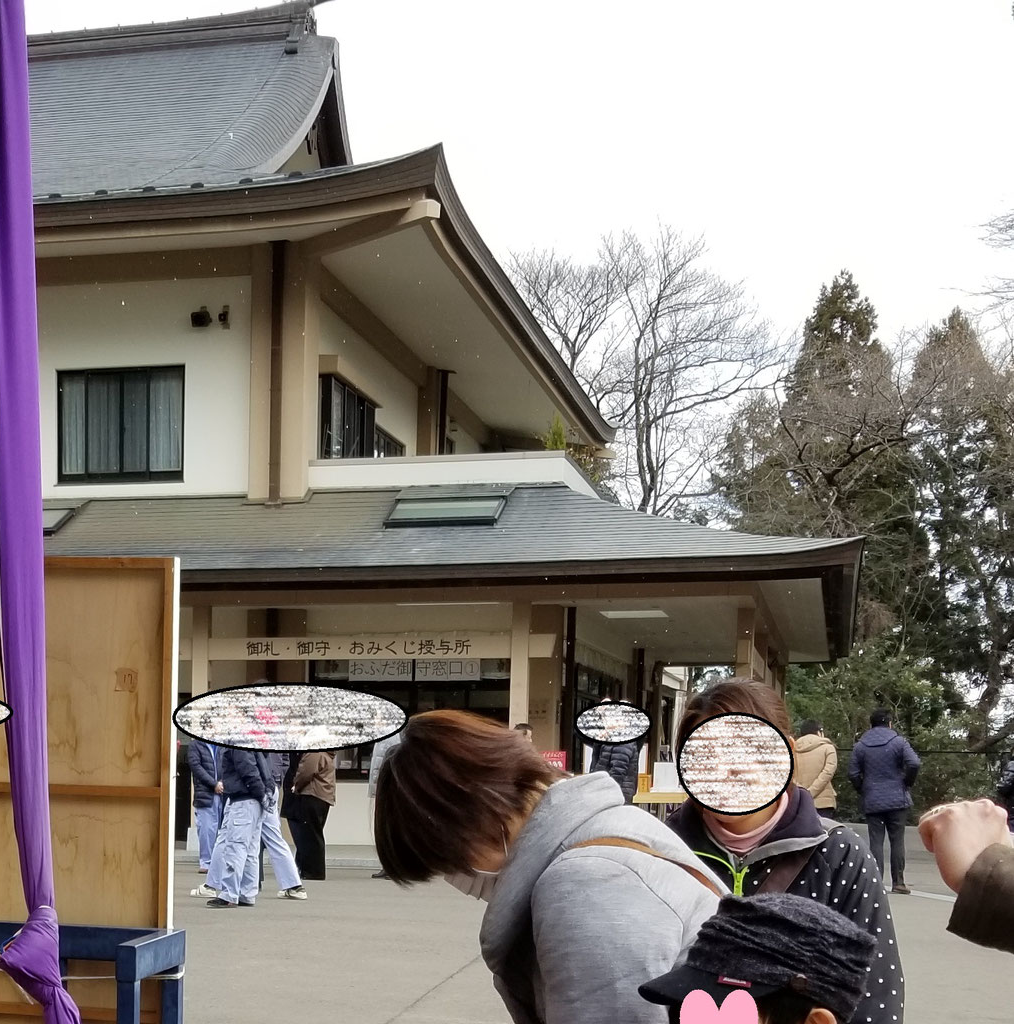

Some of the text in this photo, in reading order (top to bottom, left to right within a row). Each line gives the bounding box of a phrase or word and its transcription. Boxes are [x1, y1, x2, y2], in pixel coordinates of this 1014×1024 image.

[246, 639, 472, 657] 御札・御守・おみくじ授与所
